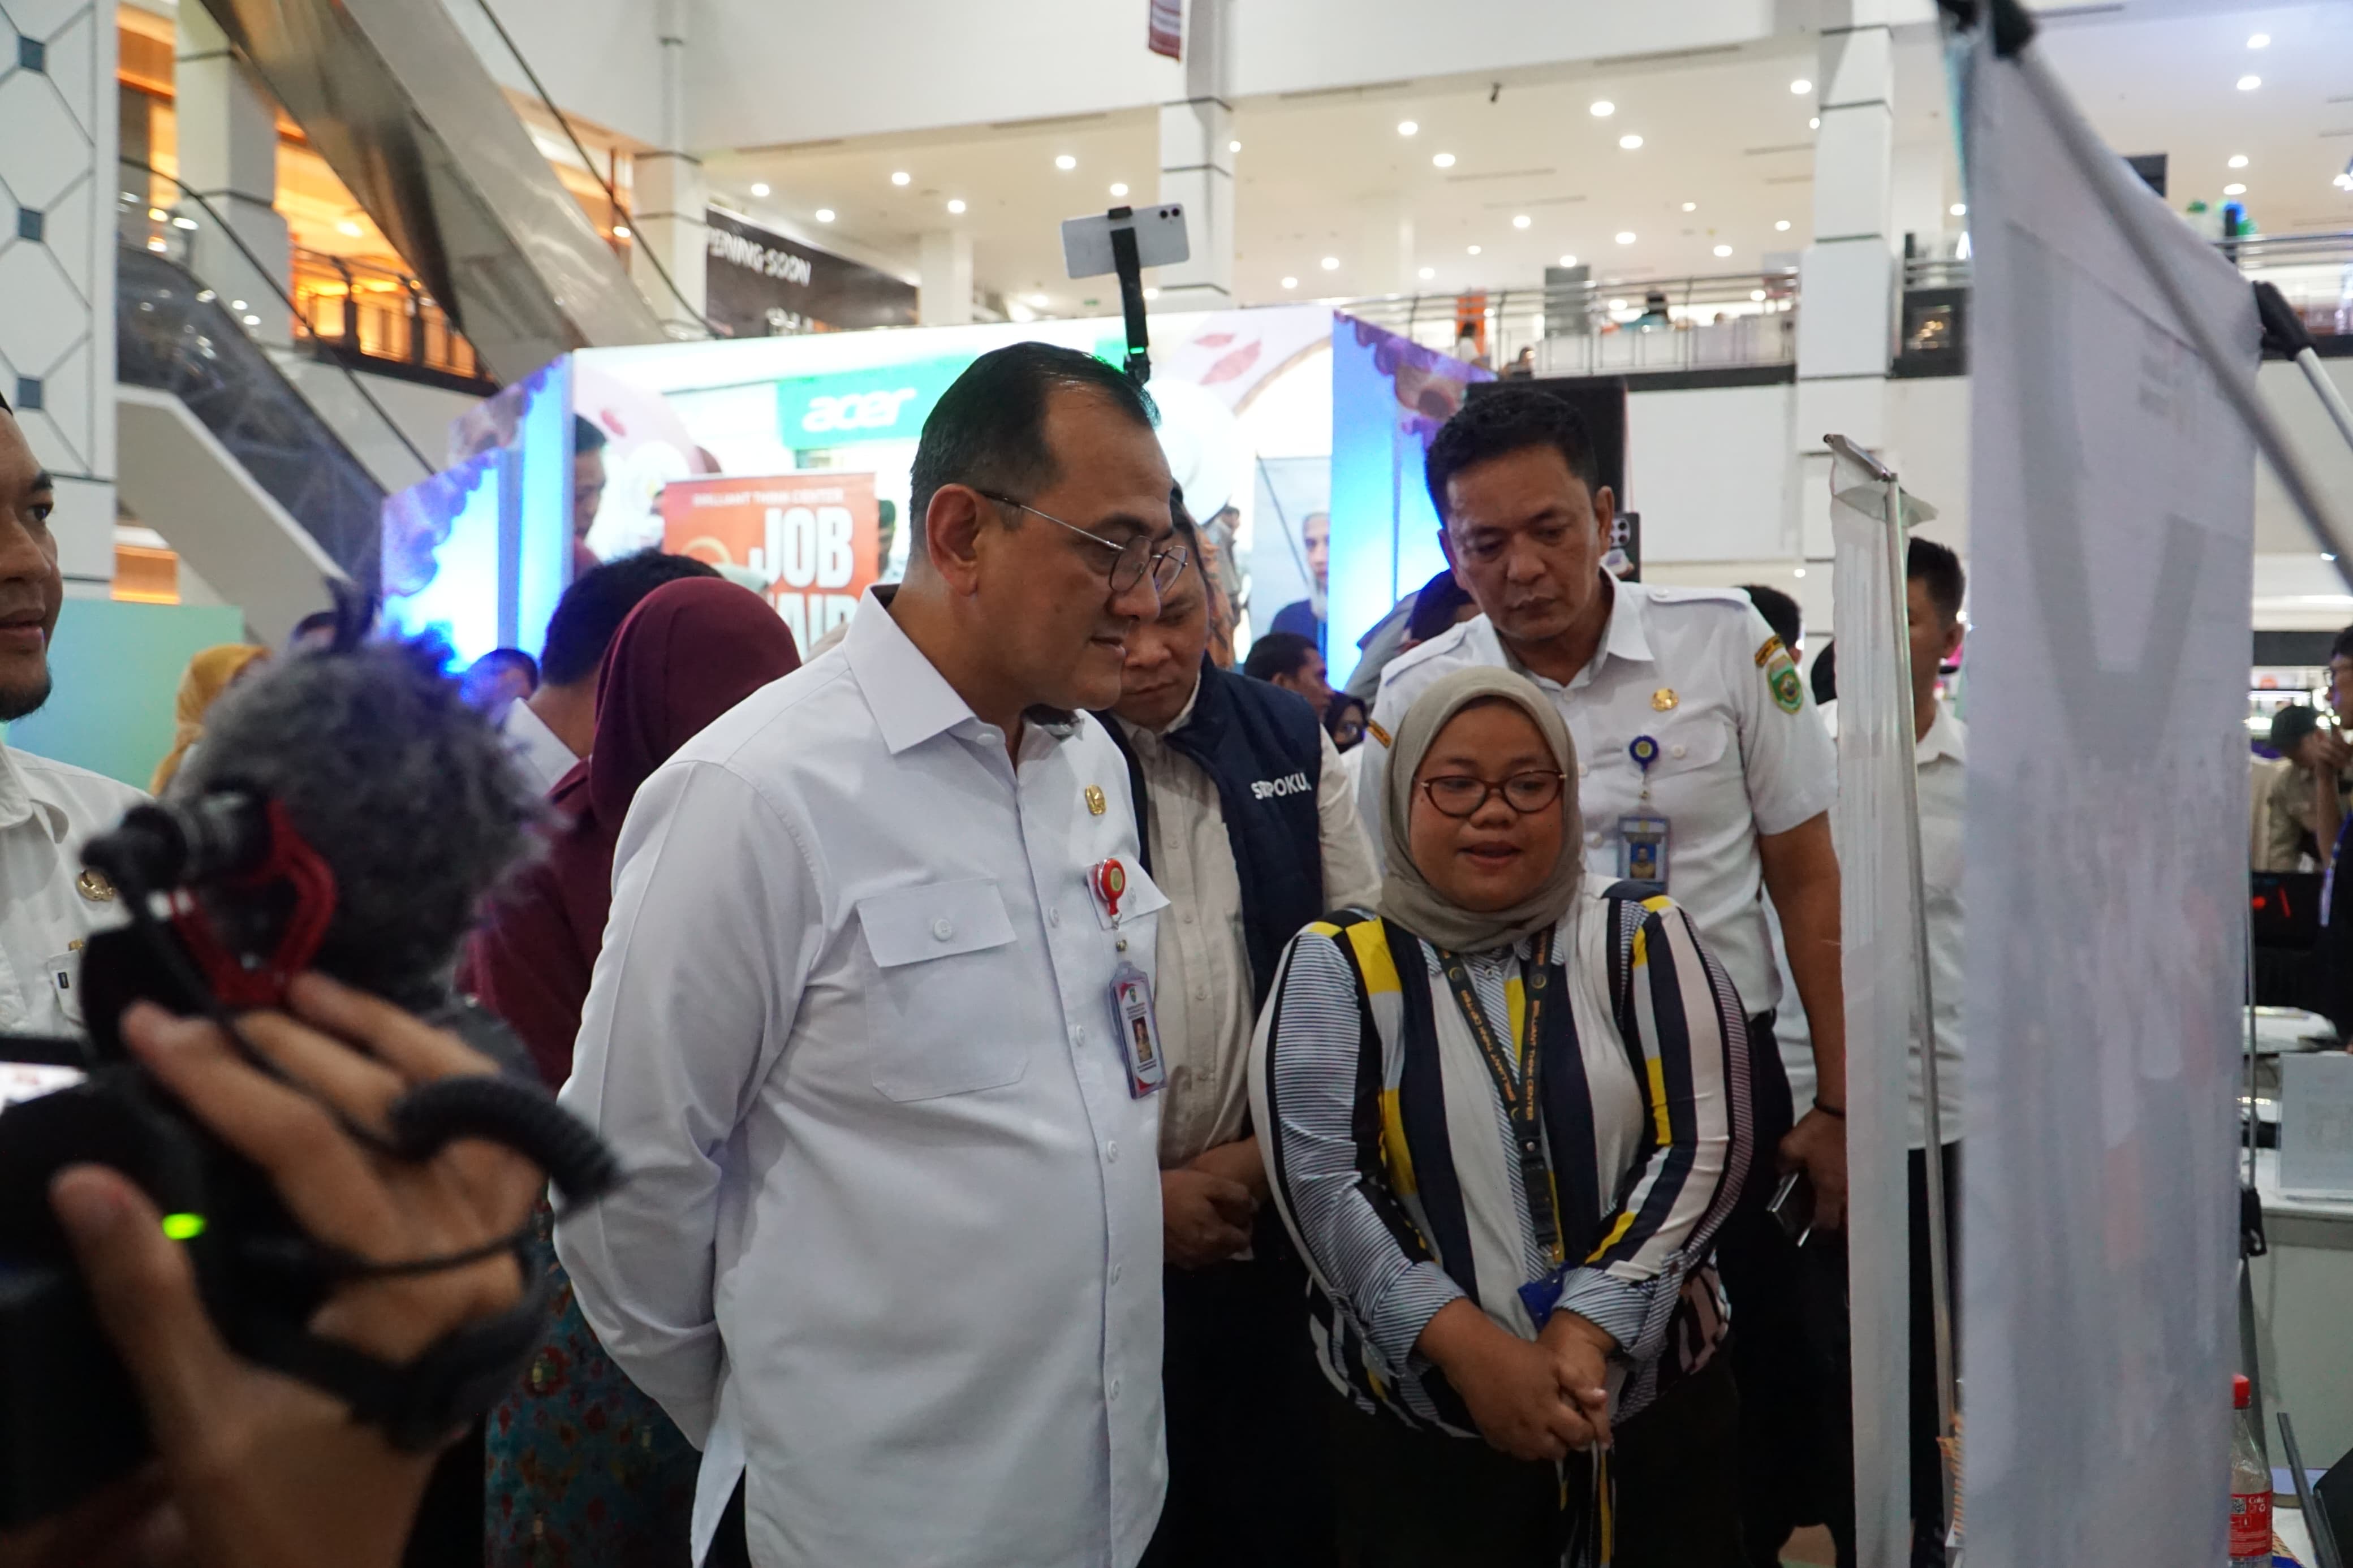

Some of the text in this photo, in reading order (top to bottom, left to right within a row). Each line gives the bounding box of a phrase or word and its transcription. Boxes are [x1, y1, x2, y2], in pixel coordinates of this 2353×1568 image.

[764, 248, 812, 287] SOON
[802, 387, 917, 433] acer
[749, 506, 854, 589] JOB
[766, 592, 859, 663] AI
[1490, 1053, 1516, 1102] BRILLIANT
[1525, 1000, 1541, 1121] BRILLIANT THINK CENTER
